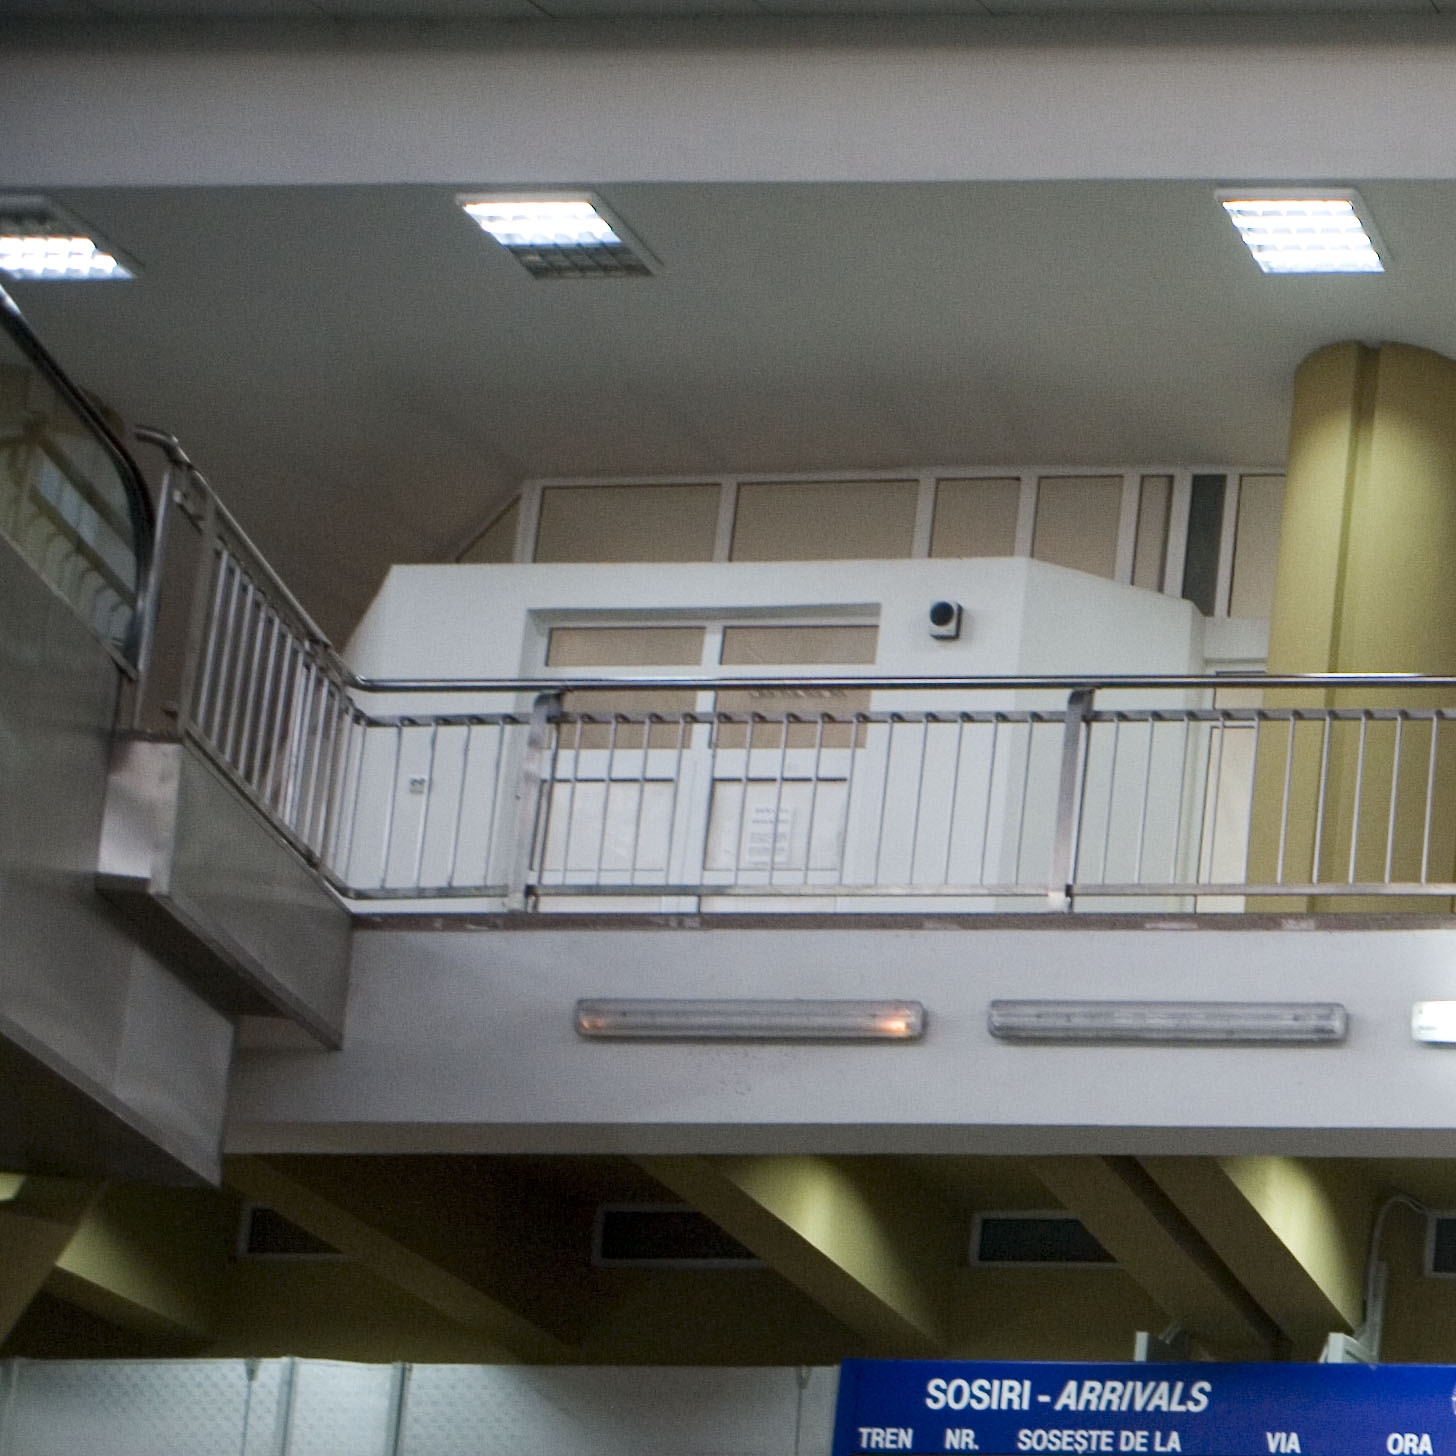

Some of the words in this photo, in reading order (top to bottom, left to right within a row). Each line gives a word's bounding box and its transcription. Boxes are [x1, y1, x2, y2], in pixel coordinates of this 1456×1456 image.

[925, 1378, 1031, 1411] SOSIRI
[1053, 1380, 1212, 1413] ARRIVALS
[859, 1427, 913, 1449] TREN
[944, 1428, 979, 1450] NR.
[1119, 1430, 1149, 1452] DE
[1153, 1430, 1182, 1452] LA
[1266, 1431, 1302, 1454] VIA
[1386, 1432, 1434, 1456] ORA
